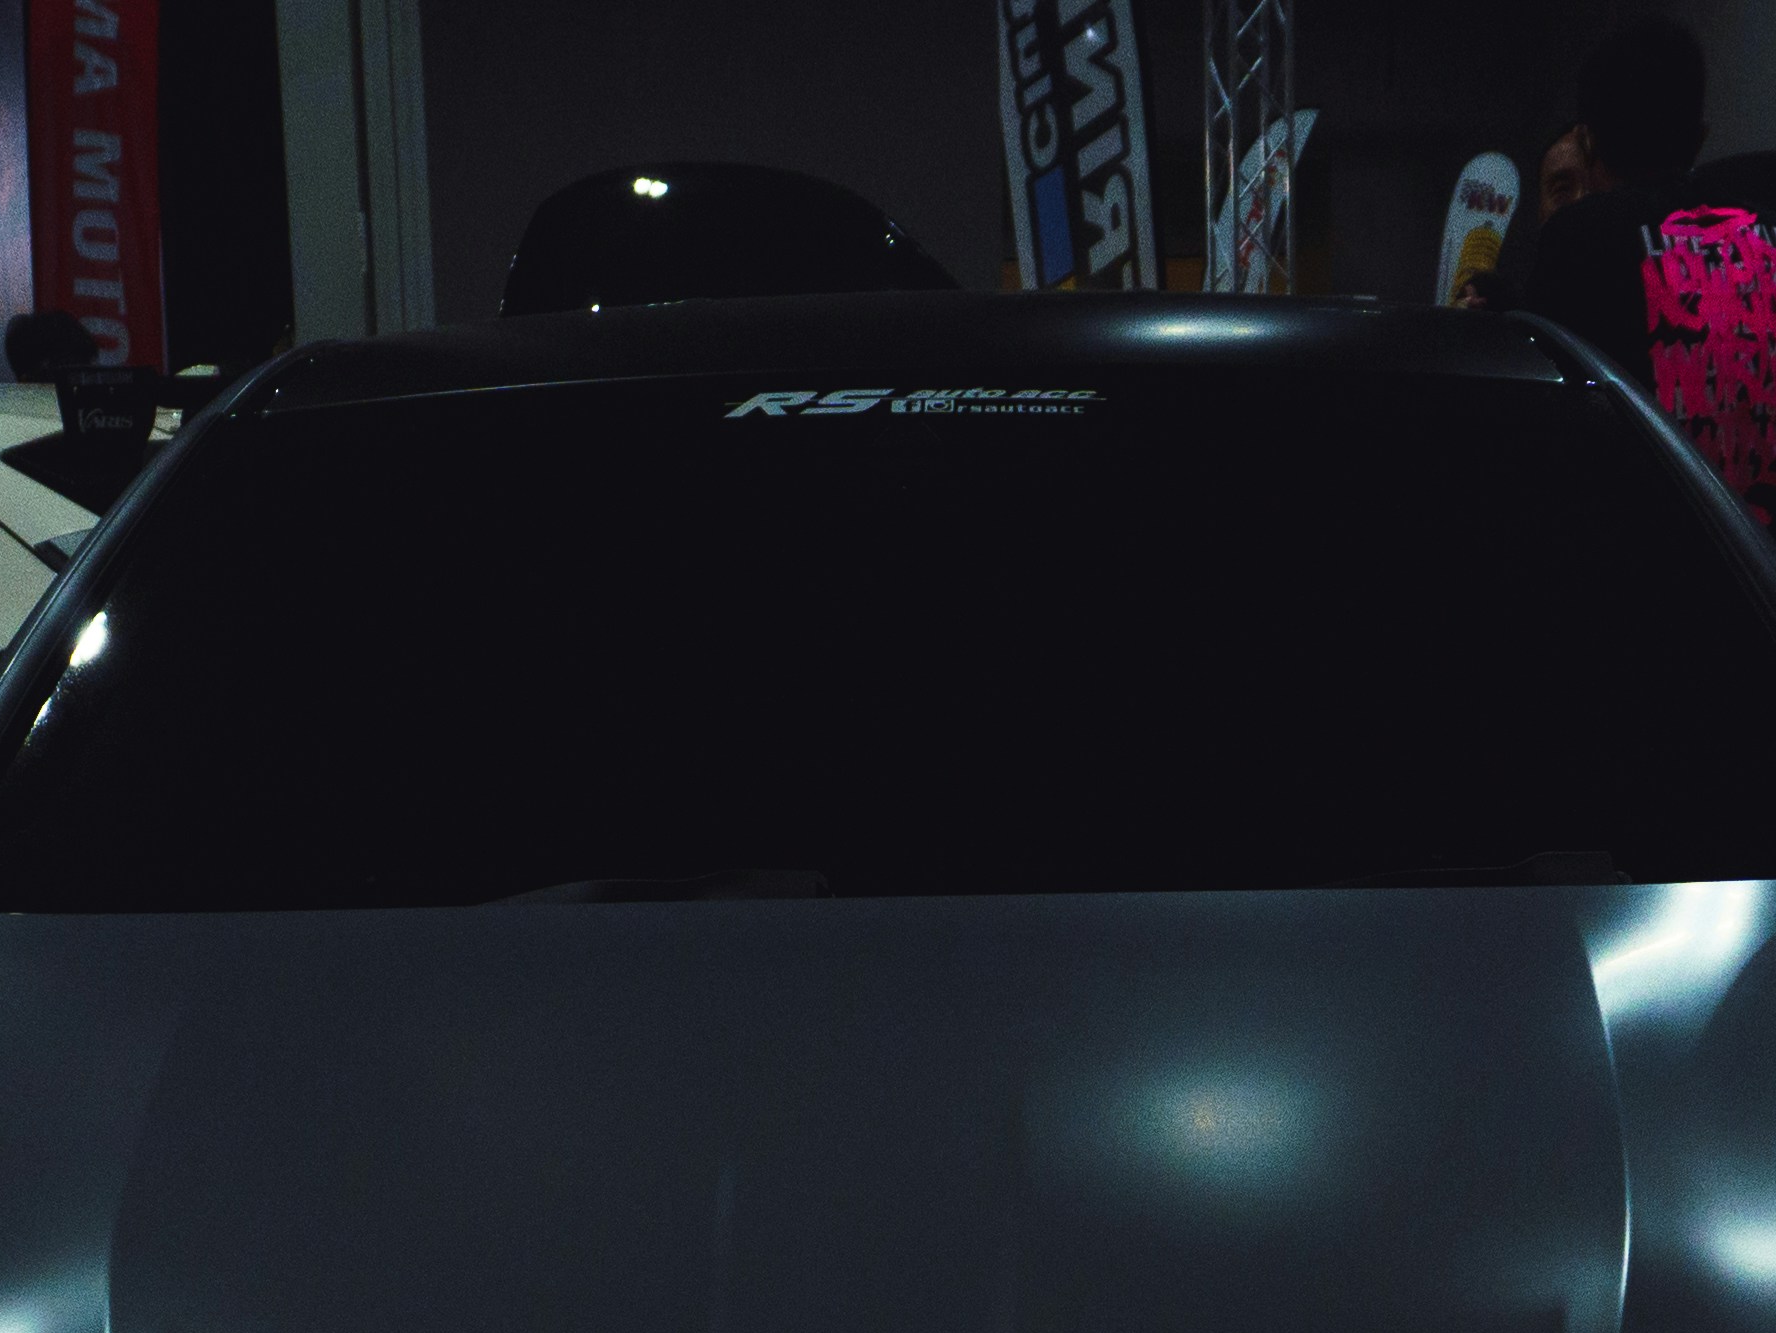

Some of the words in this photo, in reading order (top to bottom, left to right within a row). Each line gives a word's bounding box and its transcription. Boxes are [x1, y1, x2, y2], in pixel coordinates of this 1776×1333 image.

[724, 387, 895, 418] RS
[904, 385, 1005, 400] auto
[1011, 389, 1098, 400] acc
[956, 403, 1085, 414] rsautoacc
